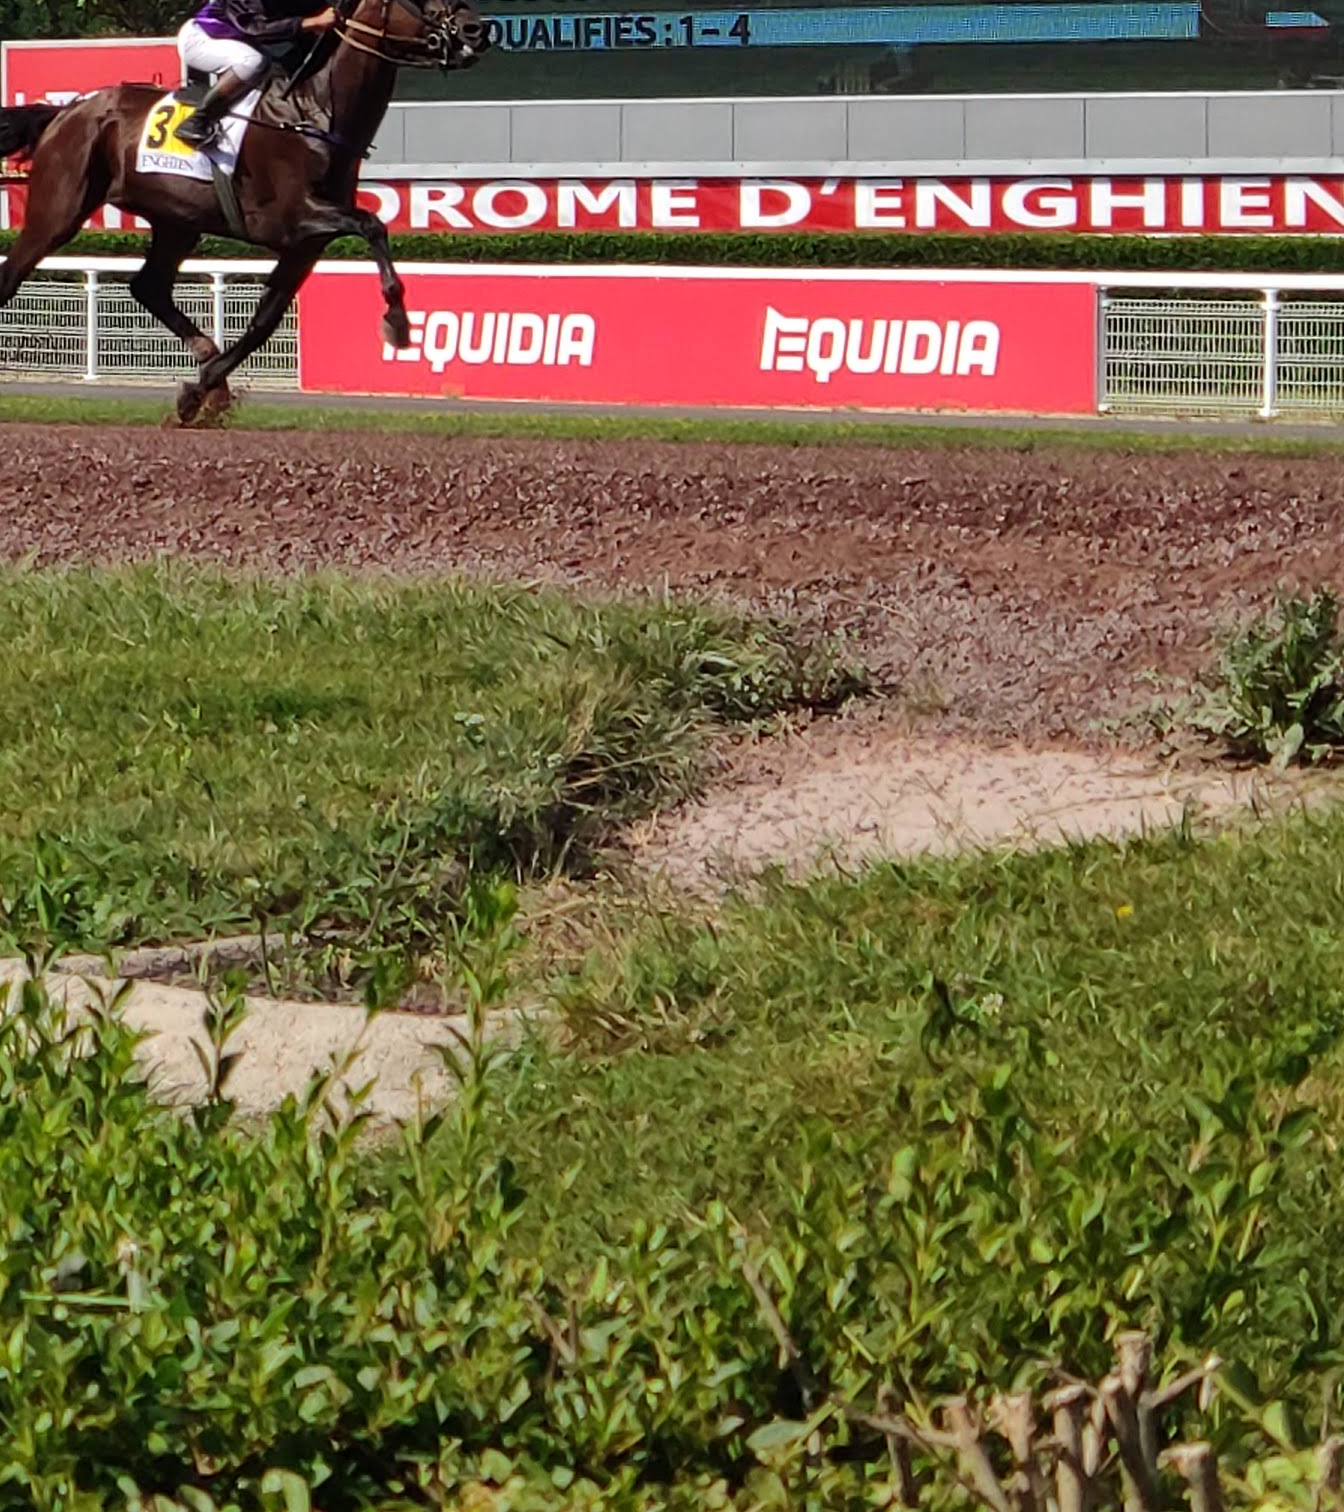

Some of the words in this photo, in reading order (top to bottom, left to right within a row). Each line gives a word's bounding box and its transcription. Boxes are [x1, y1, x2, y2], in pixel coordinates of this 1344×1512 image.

[146, 105, 175, 148] 3
[739, 177, 1344, 229] D'ENGHIEN
[759, 305, 1001, 382] EQUIDIA
